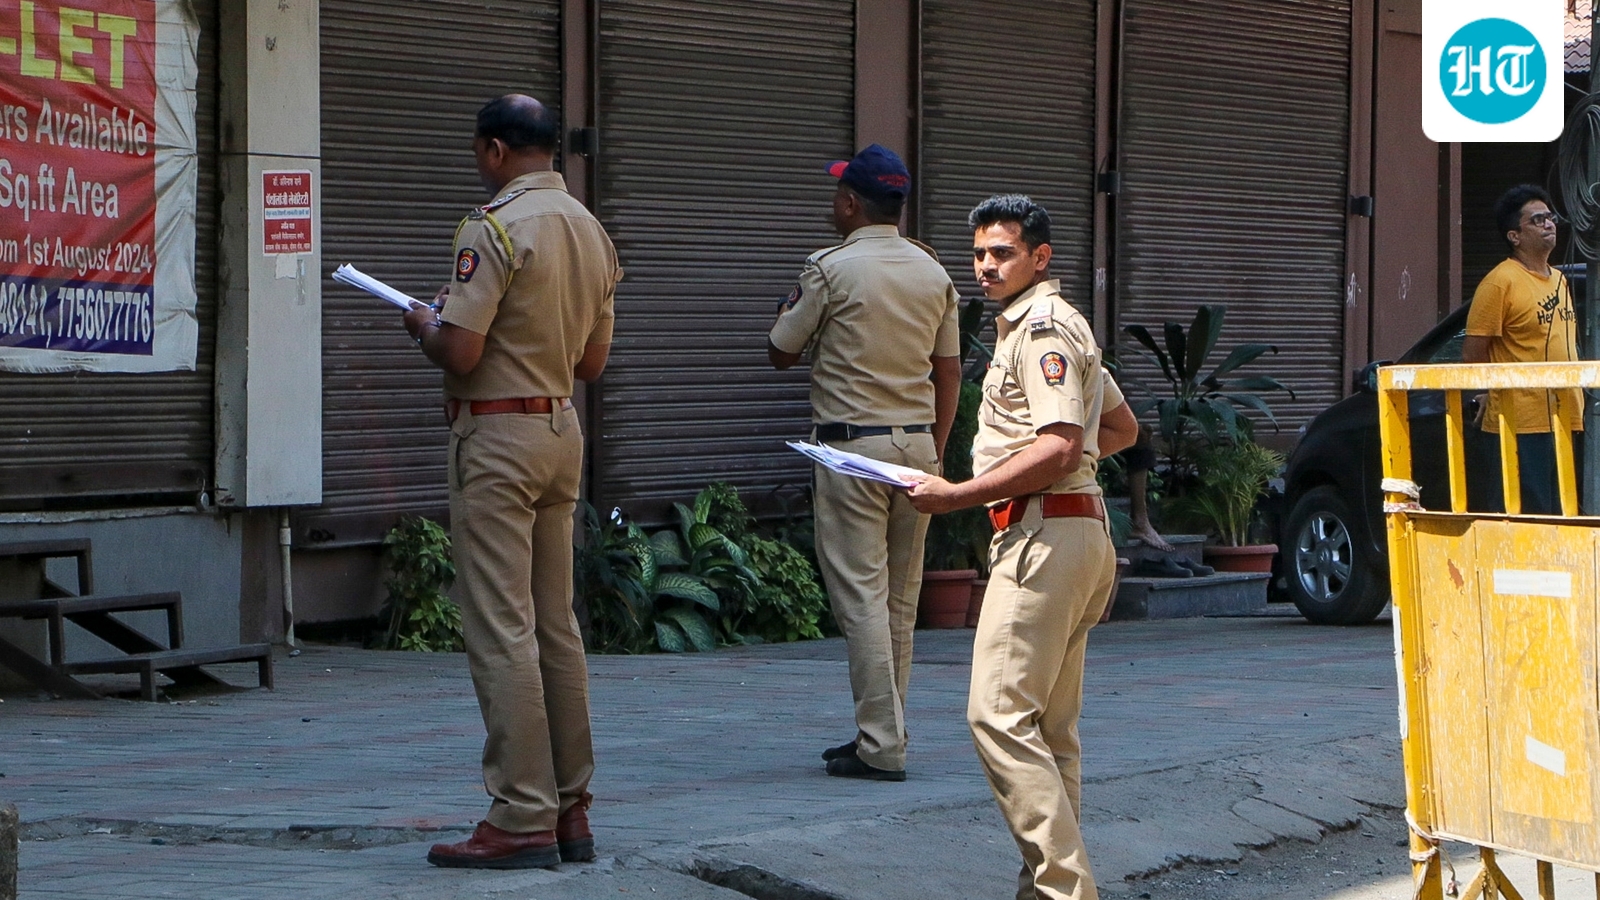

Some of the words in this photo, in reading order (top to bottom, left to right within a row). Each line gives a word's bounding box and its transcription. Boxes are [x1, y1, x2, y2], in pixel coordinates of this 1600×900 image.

[35, 97, 147, 156] Available
[0, 158, 56, 222] Sq.ft
[61, 167, 119, 219] Area
[24, 233, 50, 267] 1st
[52, 236, 110, 277] August
[114, 241, 152, 274] 2024
[57, 286, 151, 343] 7756077776
